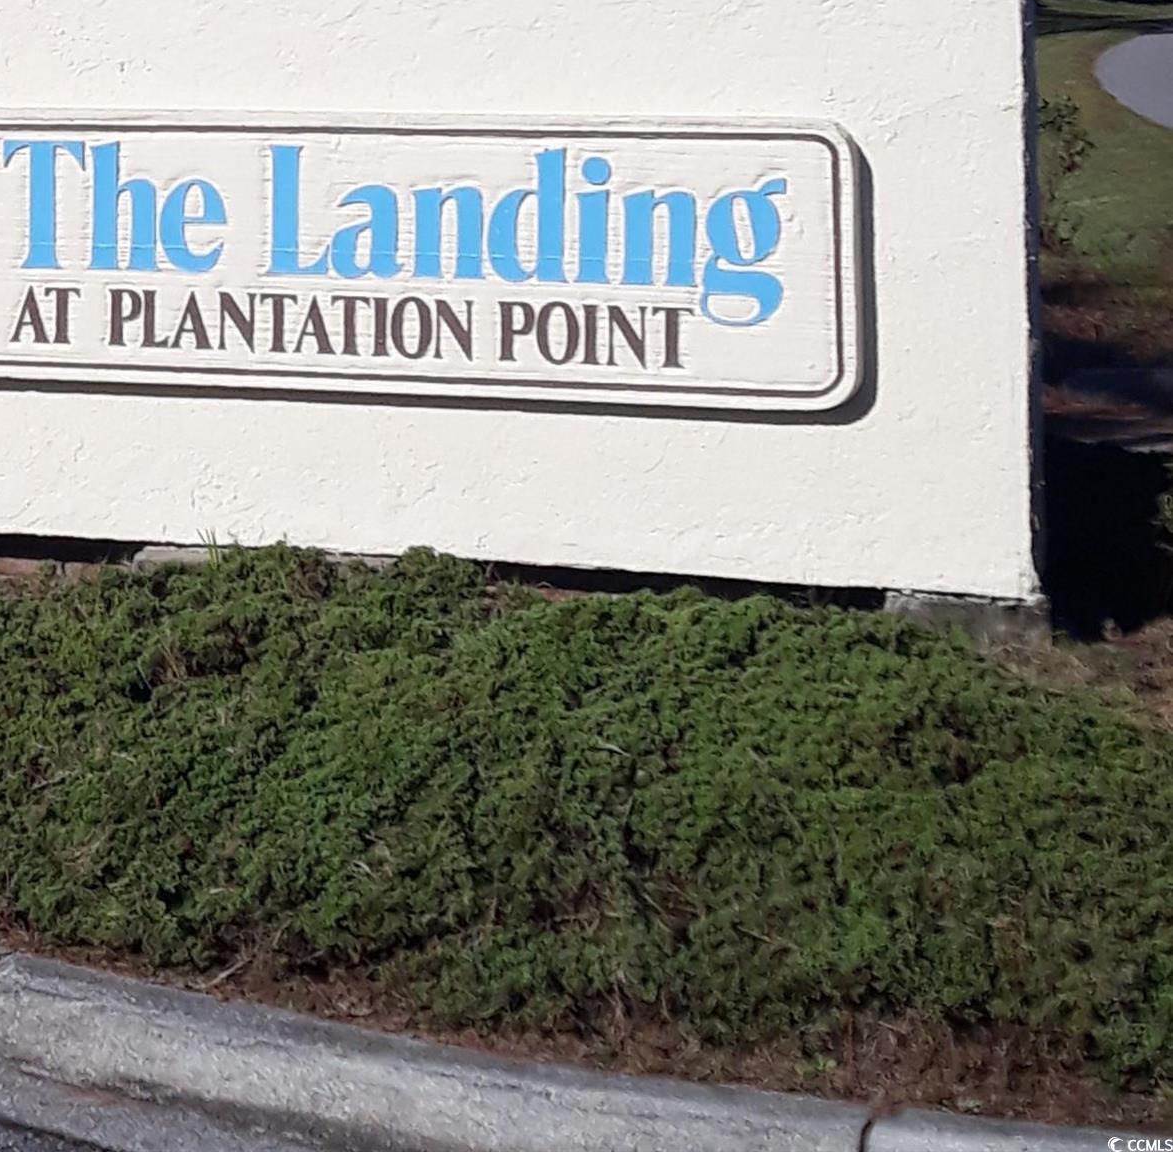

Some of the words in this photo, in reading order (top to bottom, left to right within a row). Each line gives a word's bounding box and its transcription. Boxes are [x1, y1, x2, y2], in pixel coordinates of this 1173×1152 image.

[2, 138, 226, 273] The
[269, 145, 787, 323] Landing
[9, 285, 82, 345] AT
[107, 288, 474, 361] PLANTATION
[497, 301, 696, 369] POINT
